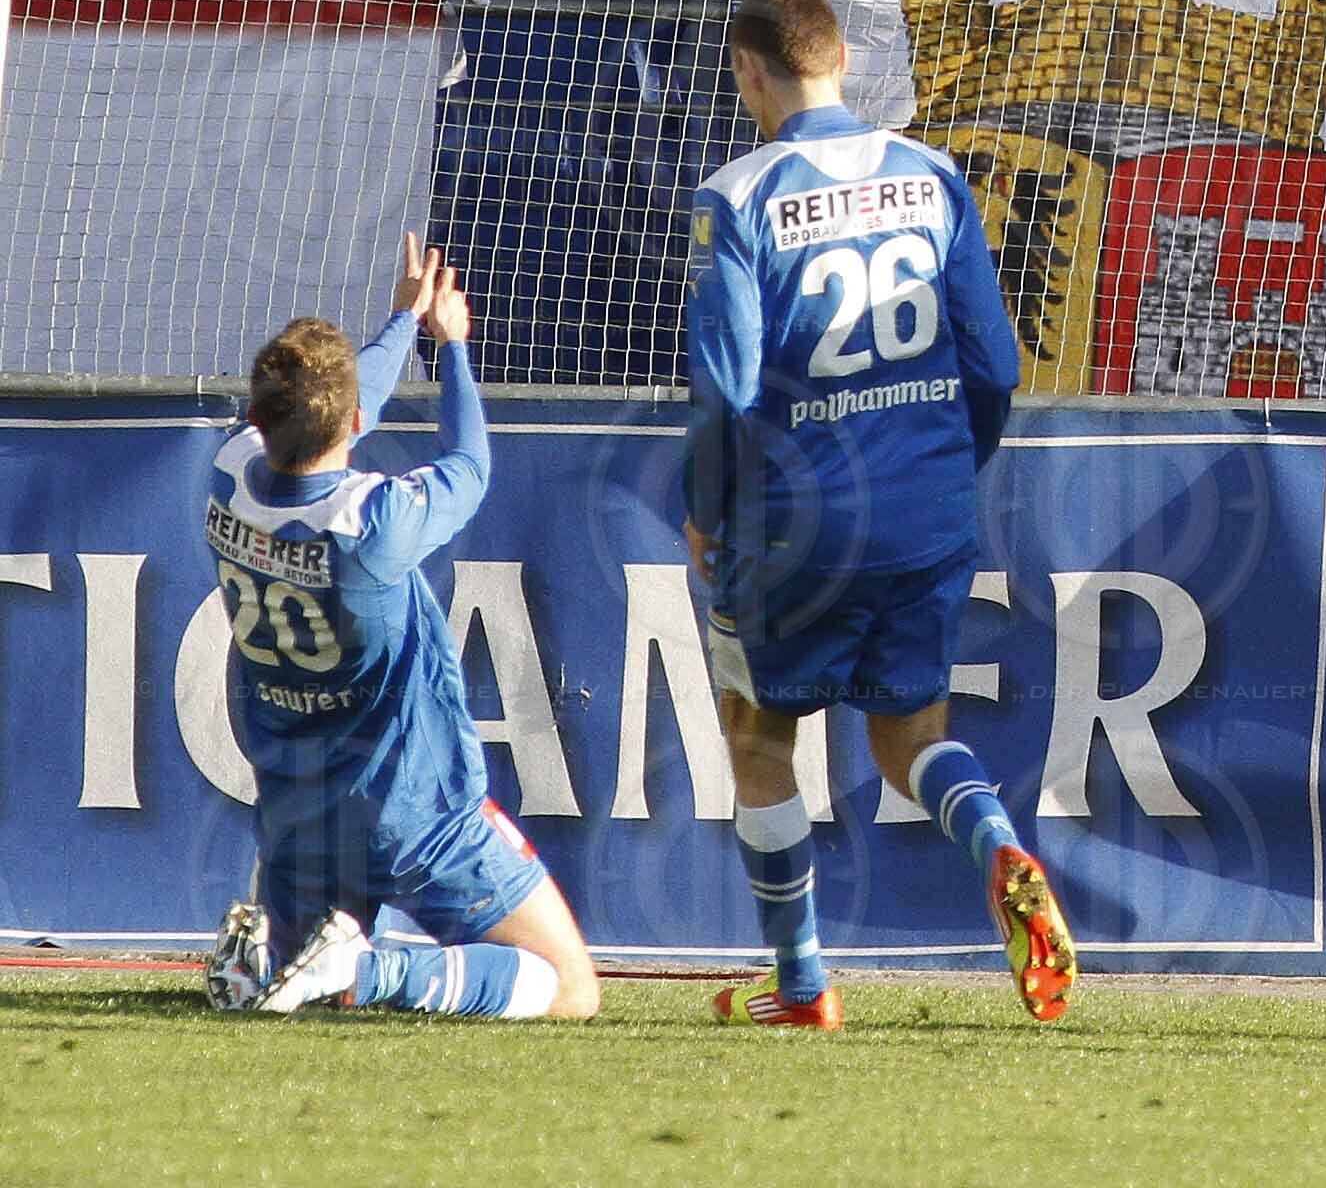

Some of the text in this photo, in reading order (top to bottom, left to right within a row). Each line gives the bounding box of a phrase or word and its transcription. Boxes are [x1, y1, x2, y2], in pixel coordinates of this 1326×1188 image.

[779, 182, 935, 229] REITERER
[802, 234, 938, 378] 26
[790, 378, 960, 428] pollhammer
[206, 503, 325, 572] REITERER
[218, 559, 342, 673] 20
